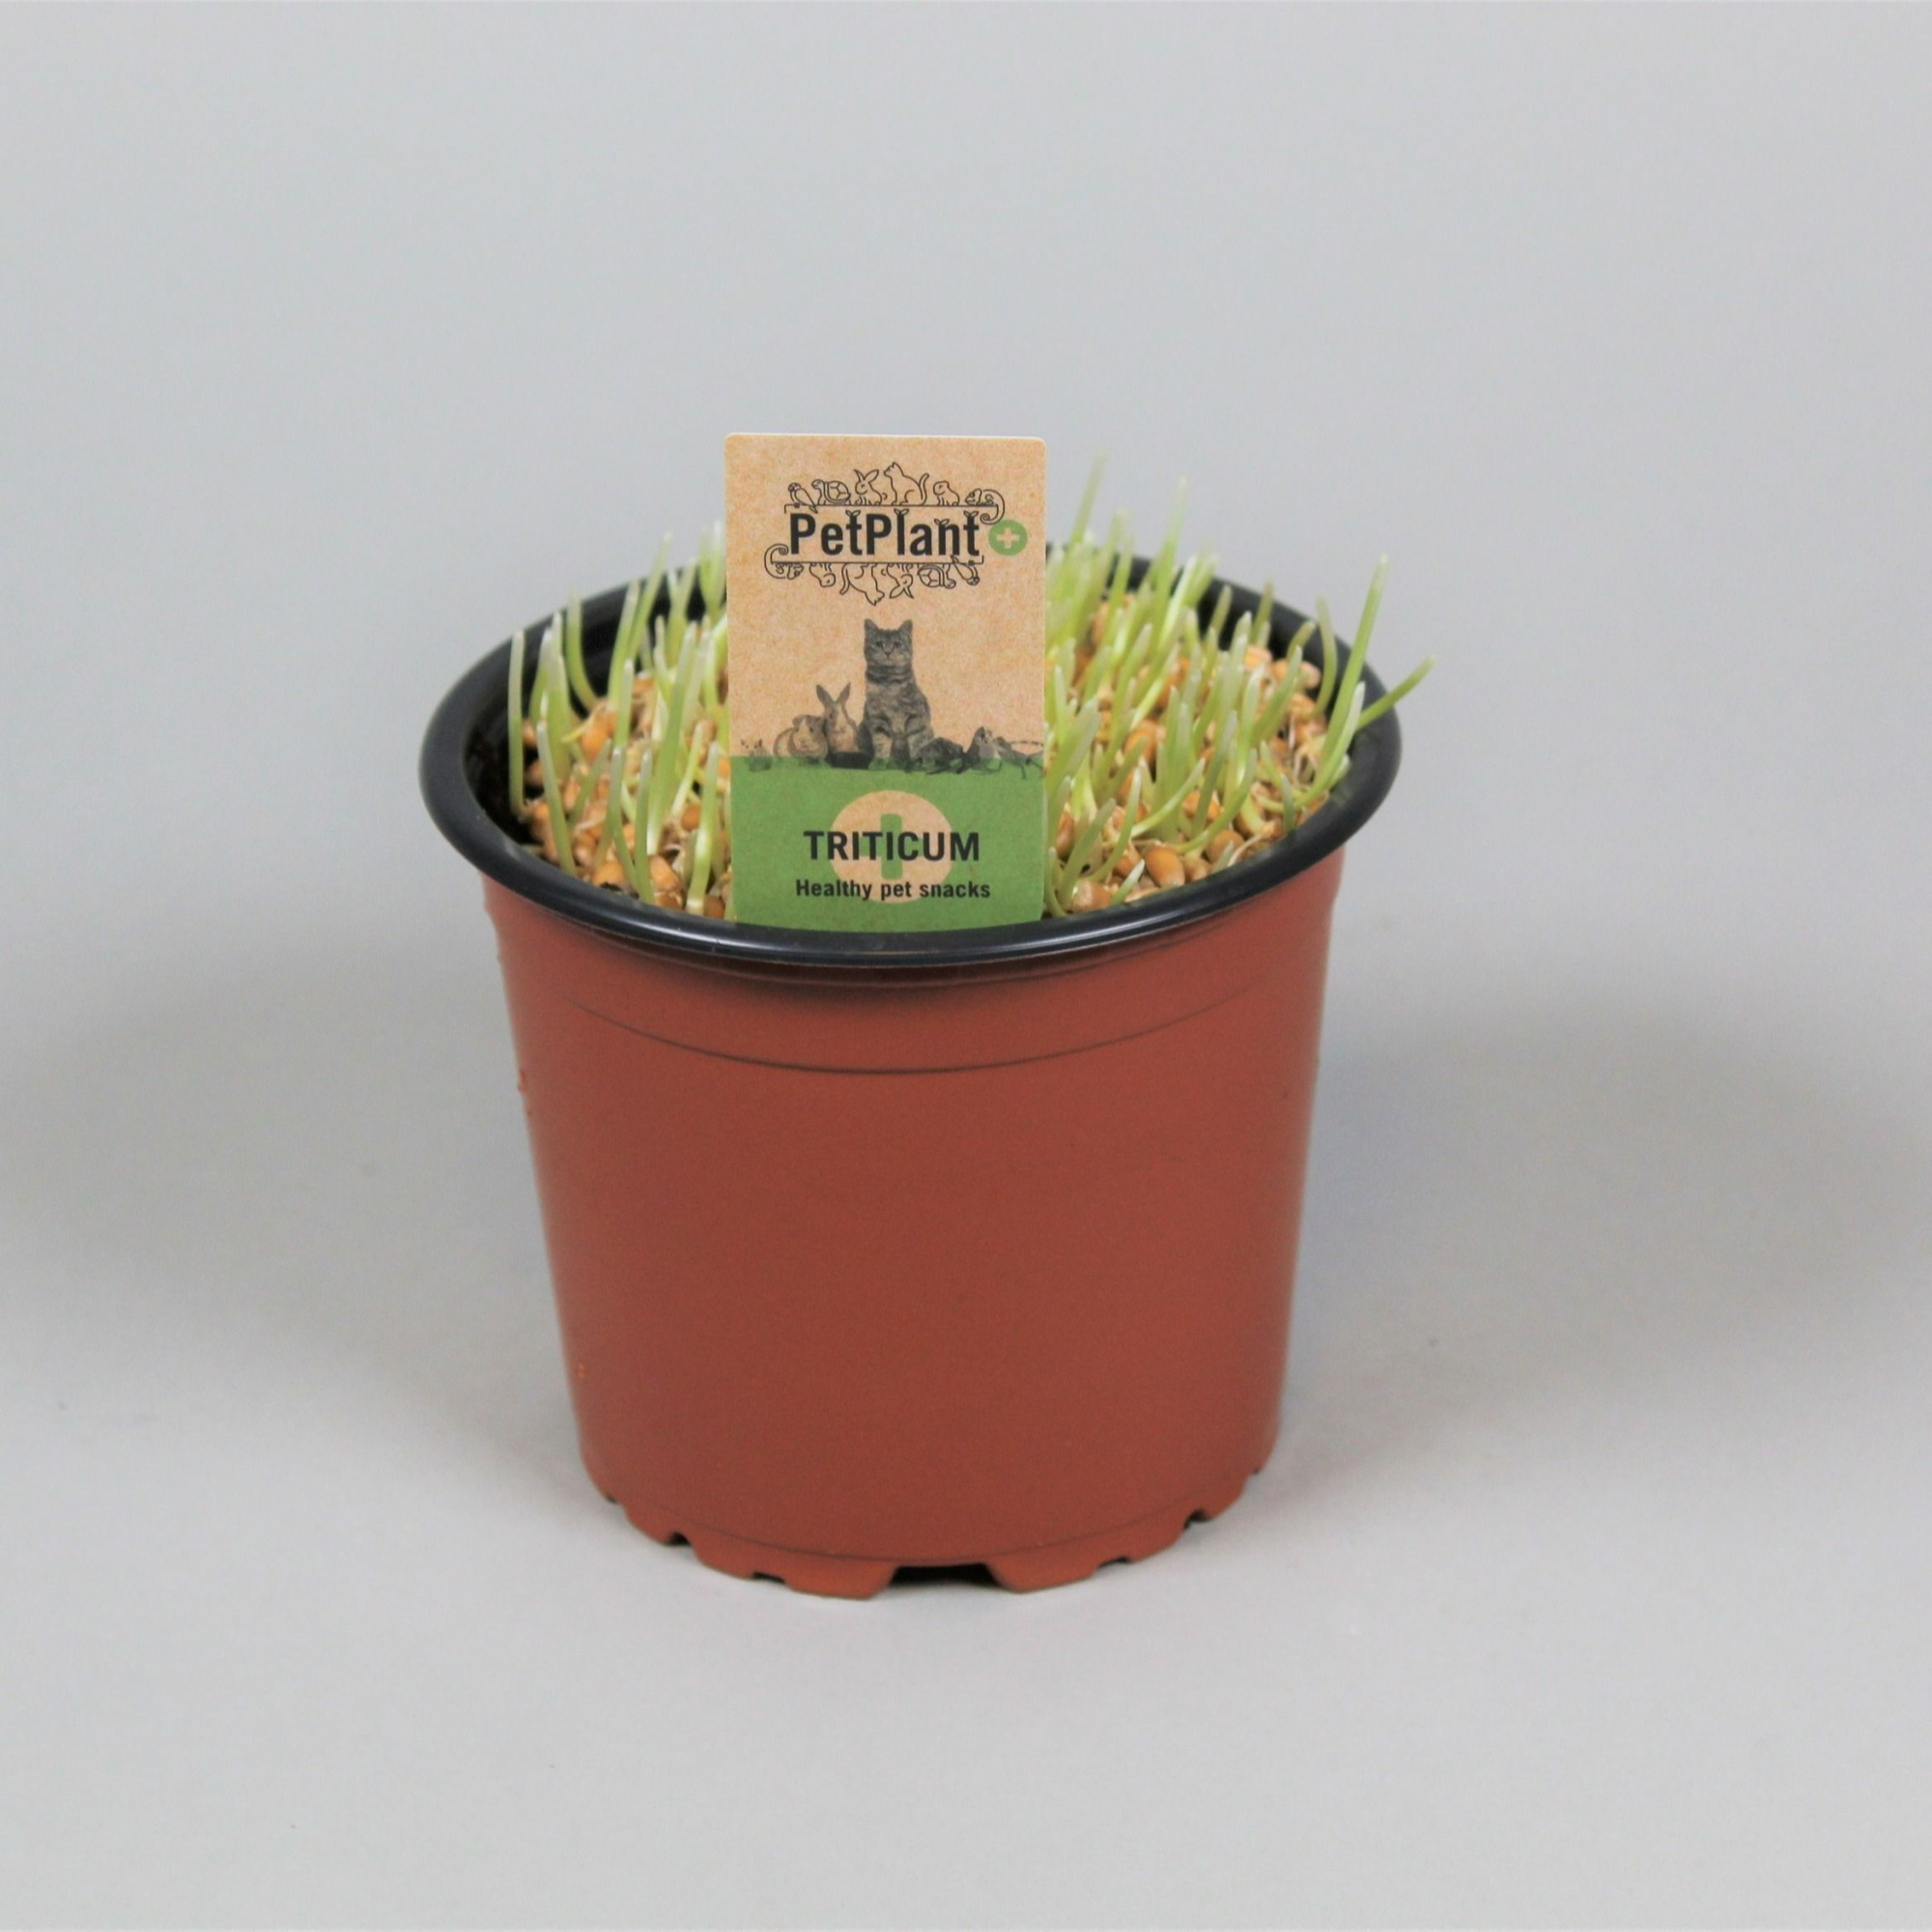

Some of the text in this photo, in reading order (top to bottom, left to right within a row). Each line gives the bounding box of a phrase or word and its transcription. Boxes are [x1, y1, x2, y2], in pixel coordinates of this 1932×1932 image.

[789, 510, 980, 556] PetPlant
[803, 830, 980, 862] TRITICUM
[795, 879, 991, 901] Healthy pet snacks
